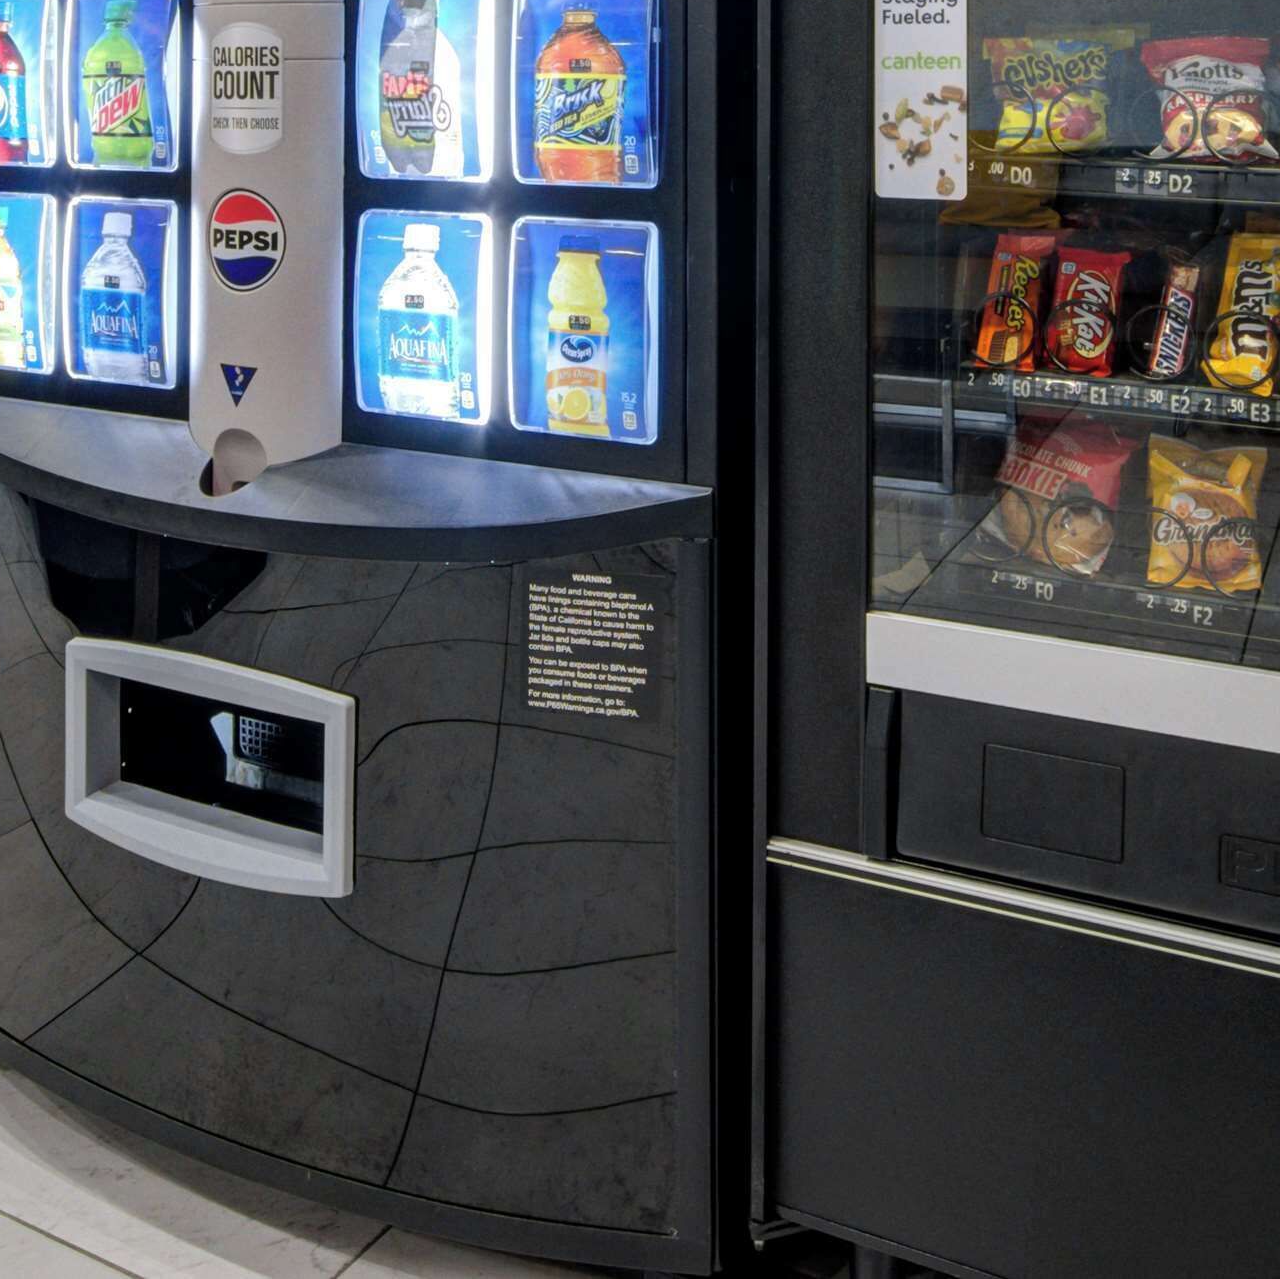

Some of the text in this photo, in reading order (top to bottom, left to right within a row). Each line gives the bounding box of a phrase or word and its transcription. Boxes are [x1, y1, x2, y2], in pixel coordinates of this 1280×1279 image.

[882, 9, 950, 25] Fueled.
[213, 46, 279, 67] CALORIES
[881, 51, 961, 70] canteen
[213, 71, 279, 100] COUNT
[232, 117, 248, 130] THEN
[251, 117, 279, 130] CHOOSE
[624, 136, 636, 146] 20
[1010, 167, 1032, 184] D0
[1169, 175, 1192, 193] D2
[214, 228, 278, 252] PEPSI
[92, 310, 138, 339] AQUAFINA
[1150, 288, 1193, 374] SNICKERS
[389, 333, 448, 365] AQUAFINA
[461, 373, 471, 382] 20
[621, 393, 637, 402] 15.2
[1013, 382, 1030, 397] E0
[1251, 404, 1270, 422] E3
[572, 574, 612, 584] WARNING
[529, 584, 548, 594] Many
[551, 586, 566, 594] food
[568, 588, 581, 596] and
[584, 589, 617, 599] beverage
[1036, 583, 1053, 600] F0
[1193, 607, 1213, 625] F2
[529, 656, 542, 665] You
[569, 661, 600, 672] exposed
[602, 662, 608, 670] to
[610, 664, 626, 672] BPA
[628, 666, 647, 674] when
